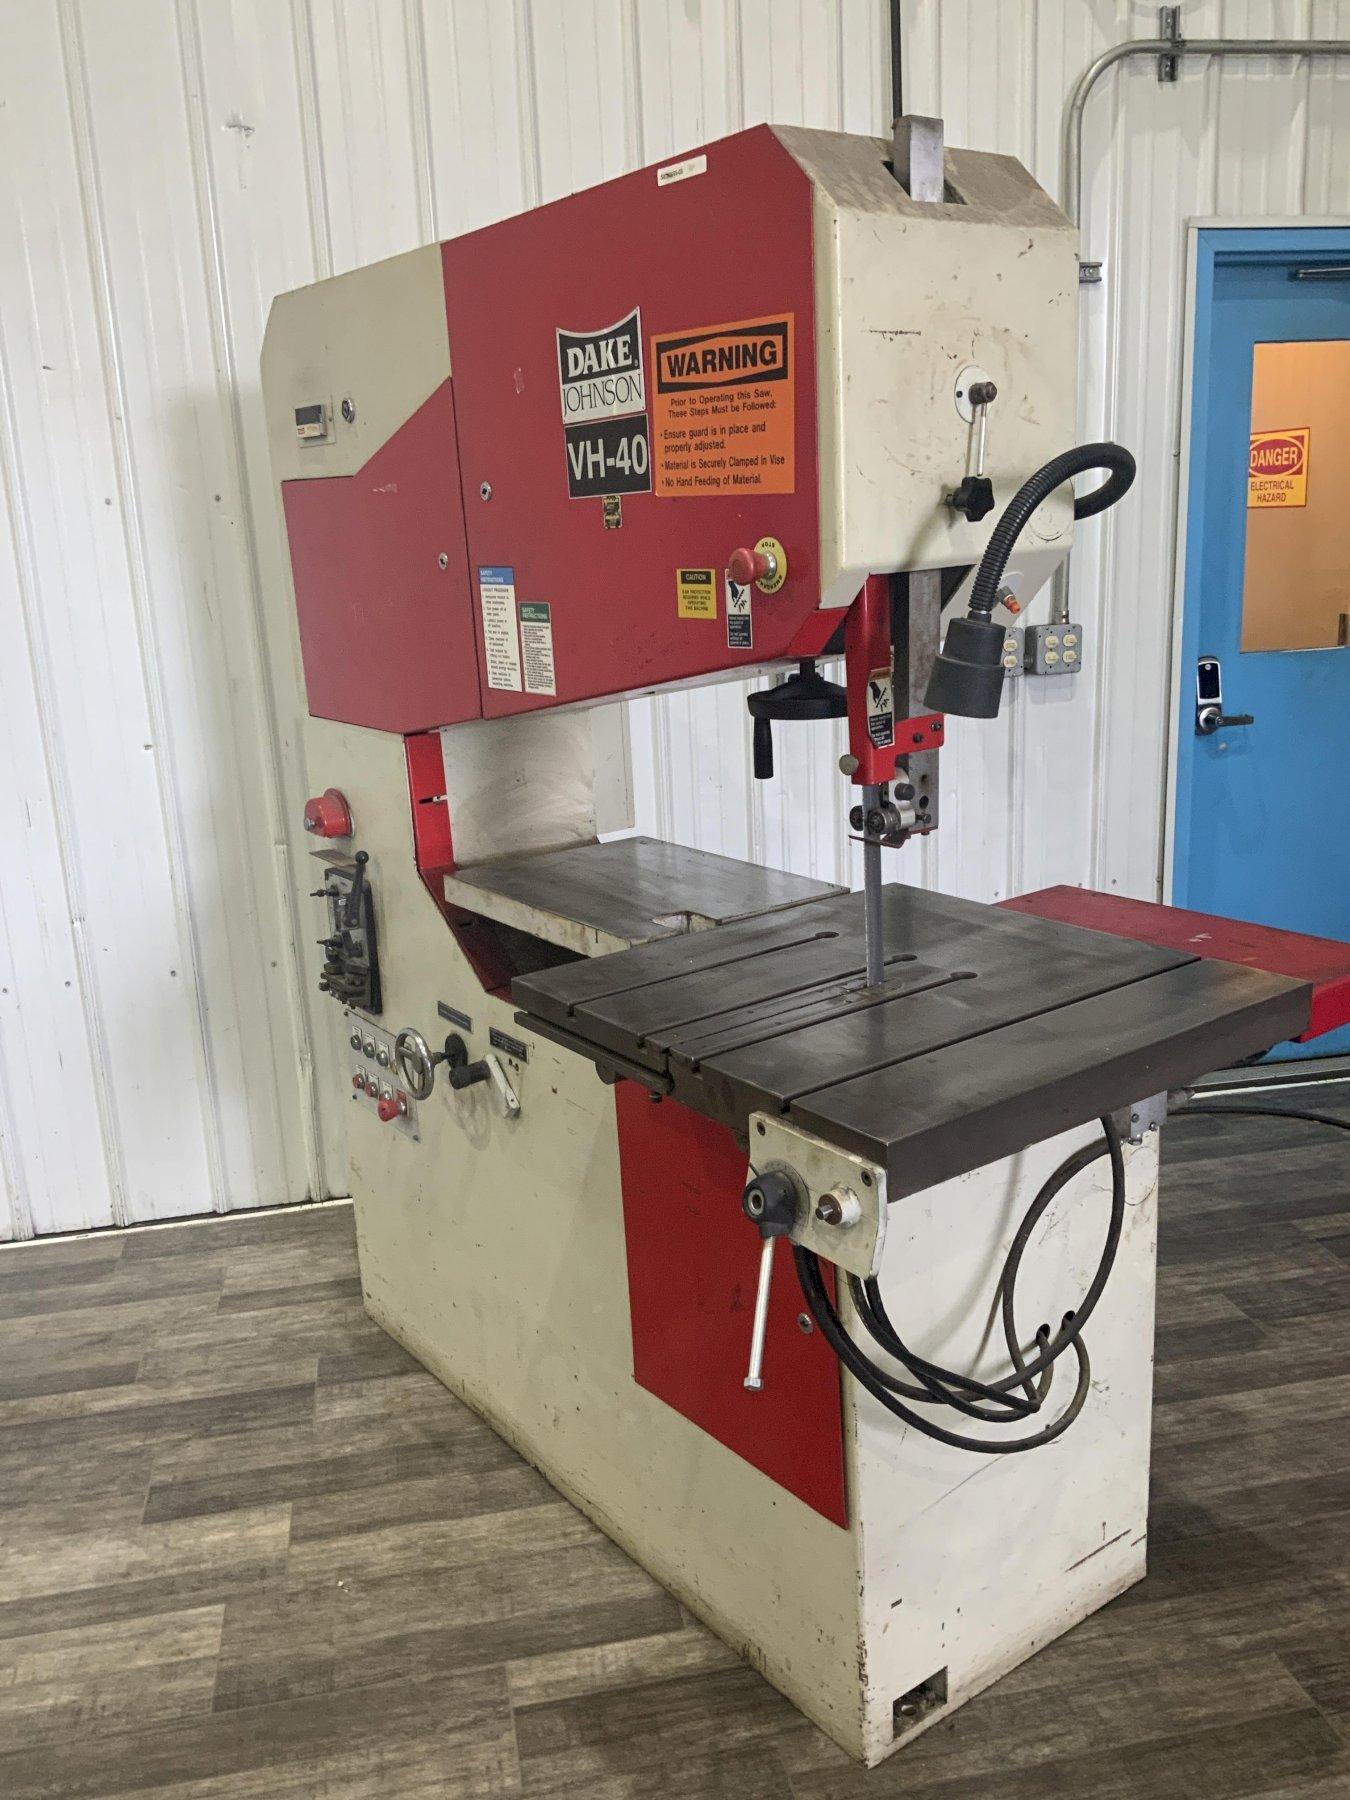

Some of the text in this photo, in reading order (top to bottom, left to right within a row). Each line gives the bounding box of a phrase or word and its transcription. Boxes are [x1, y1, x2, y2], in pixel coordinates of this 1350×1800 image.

[567, 334, 631, 378] DAKE
[666, 340, 778, 378] WARNING
[562, 373, 642, 417] JOHNSON
[670, 398, 687, 407] Prior
[689, 397, 697, 405] to
[699, 394, 734, 405] Operating
[737, 391, 751, 400] this
[668, 400, 777, 419] These Steps Must be Followed:
[664, 422, 766, 440] Ensure guard is in place and
[664, 440, 727, 454] properly adjusted.
[567, 433, 648, 481] VH-40
[664, 454, 785, 471] Material is Securely Clamped in Vise
[1250, 446, 1298, 467] DANGER
[665, 478, 674, 487] No
[676, 476, 693, 486] Hand
[694, 476, 721, 487] Feeding
[722, 475, 730, 485] of
[1250, 480, 1294, 491] ELECTRICAL
[1256, 492, 1287, 503] HAZARD
[685, 573, 707, 581] CAUTION
